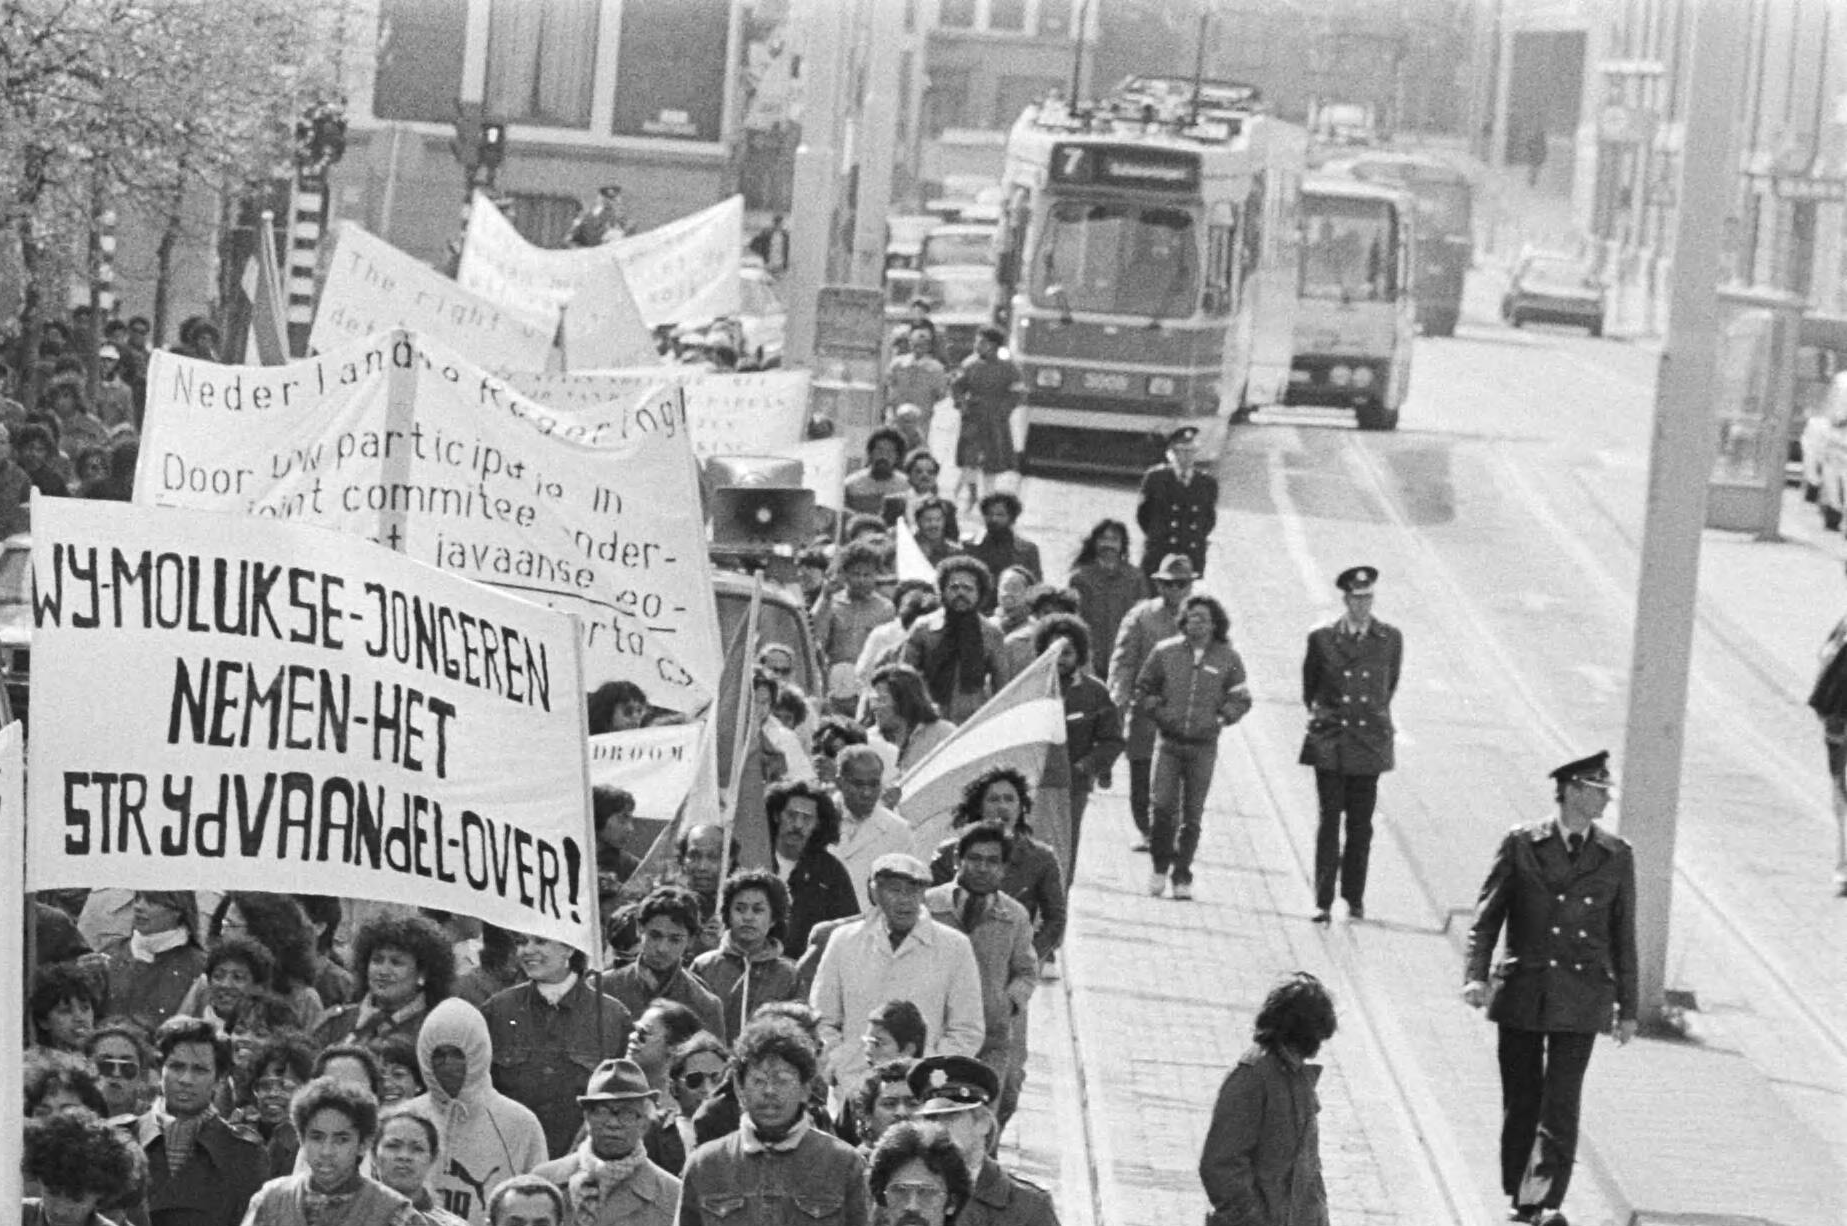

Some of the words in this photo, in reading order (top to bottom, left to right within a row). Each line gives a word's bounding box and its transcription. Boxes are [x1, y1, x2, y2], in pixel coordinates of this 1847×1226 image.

[1062, 147, 1085, 175] 7
[351, 251, 396, 292] The
[164, 453, 254, 494] Door
